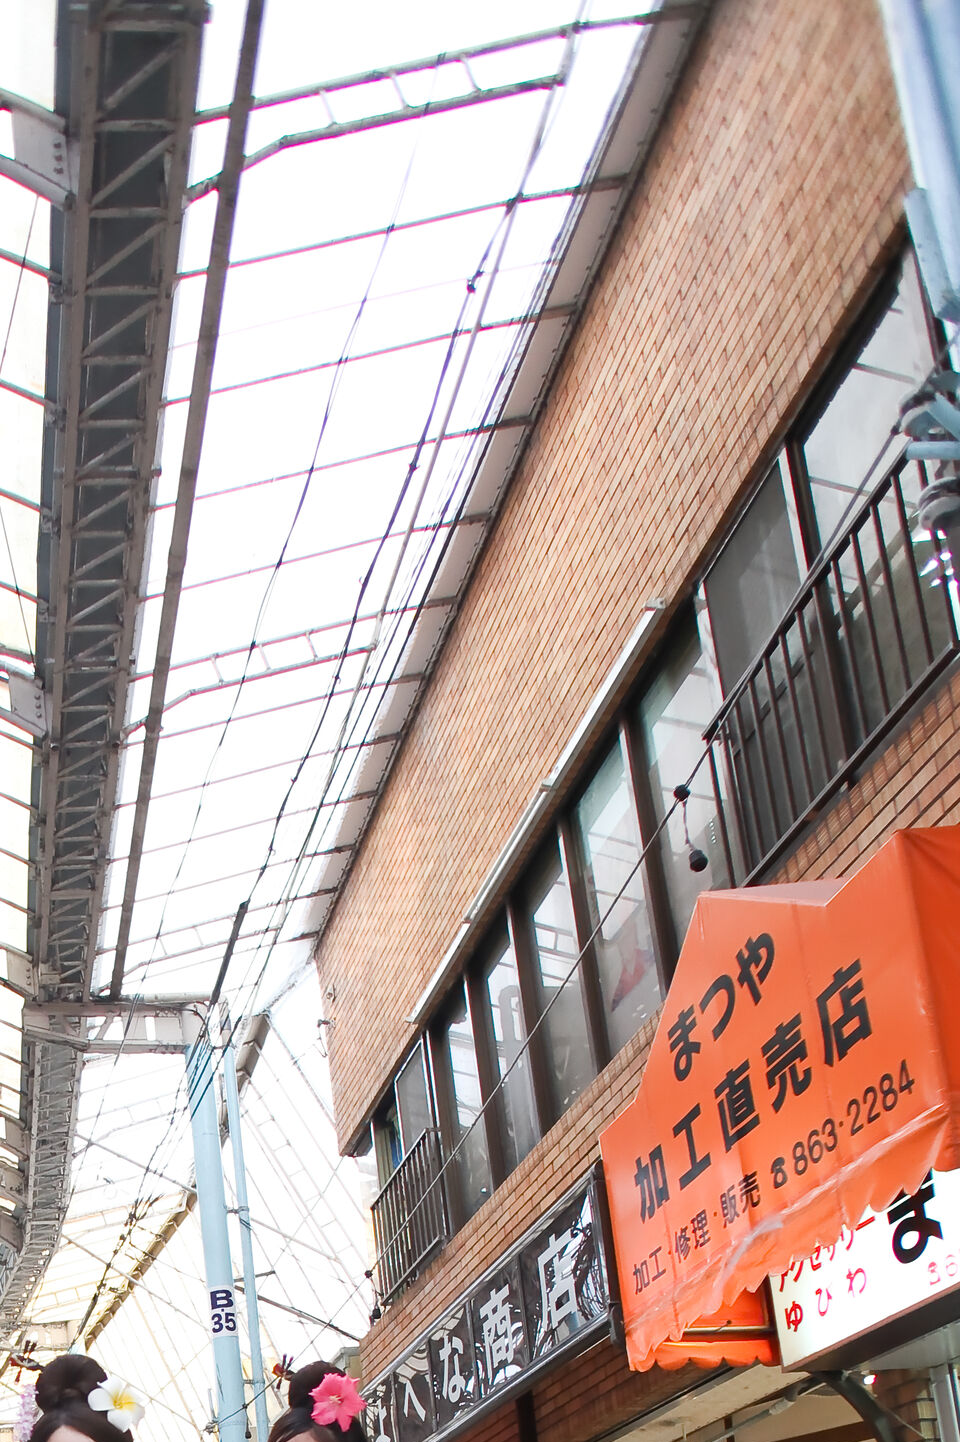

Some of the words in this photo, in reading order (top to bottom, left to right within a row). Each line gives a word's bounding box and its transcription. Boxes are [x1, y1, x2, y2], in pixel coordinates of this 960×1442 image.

[667, 932, 775, 1082] まつや
[634, 958, 873, 1223] 加工直売店
[210, 1289, 234, 1310] B
[211, 1313, 237, 1333] 35
